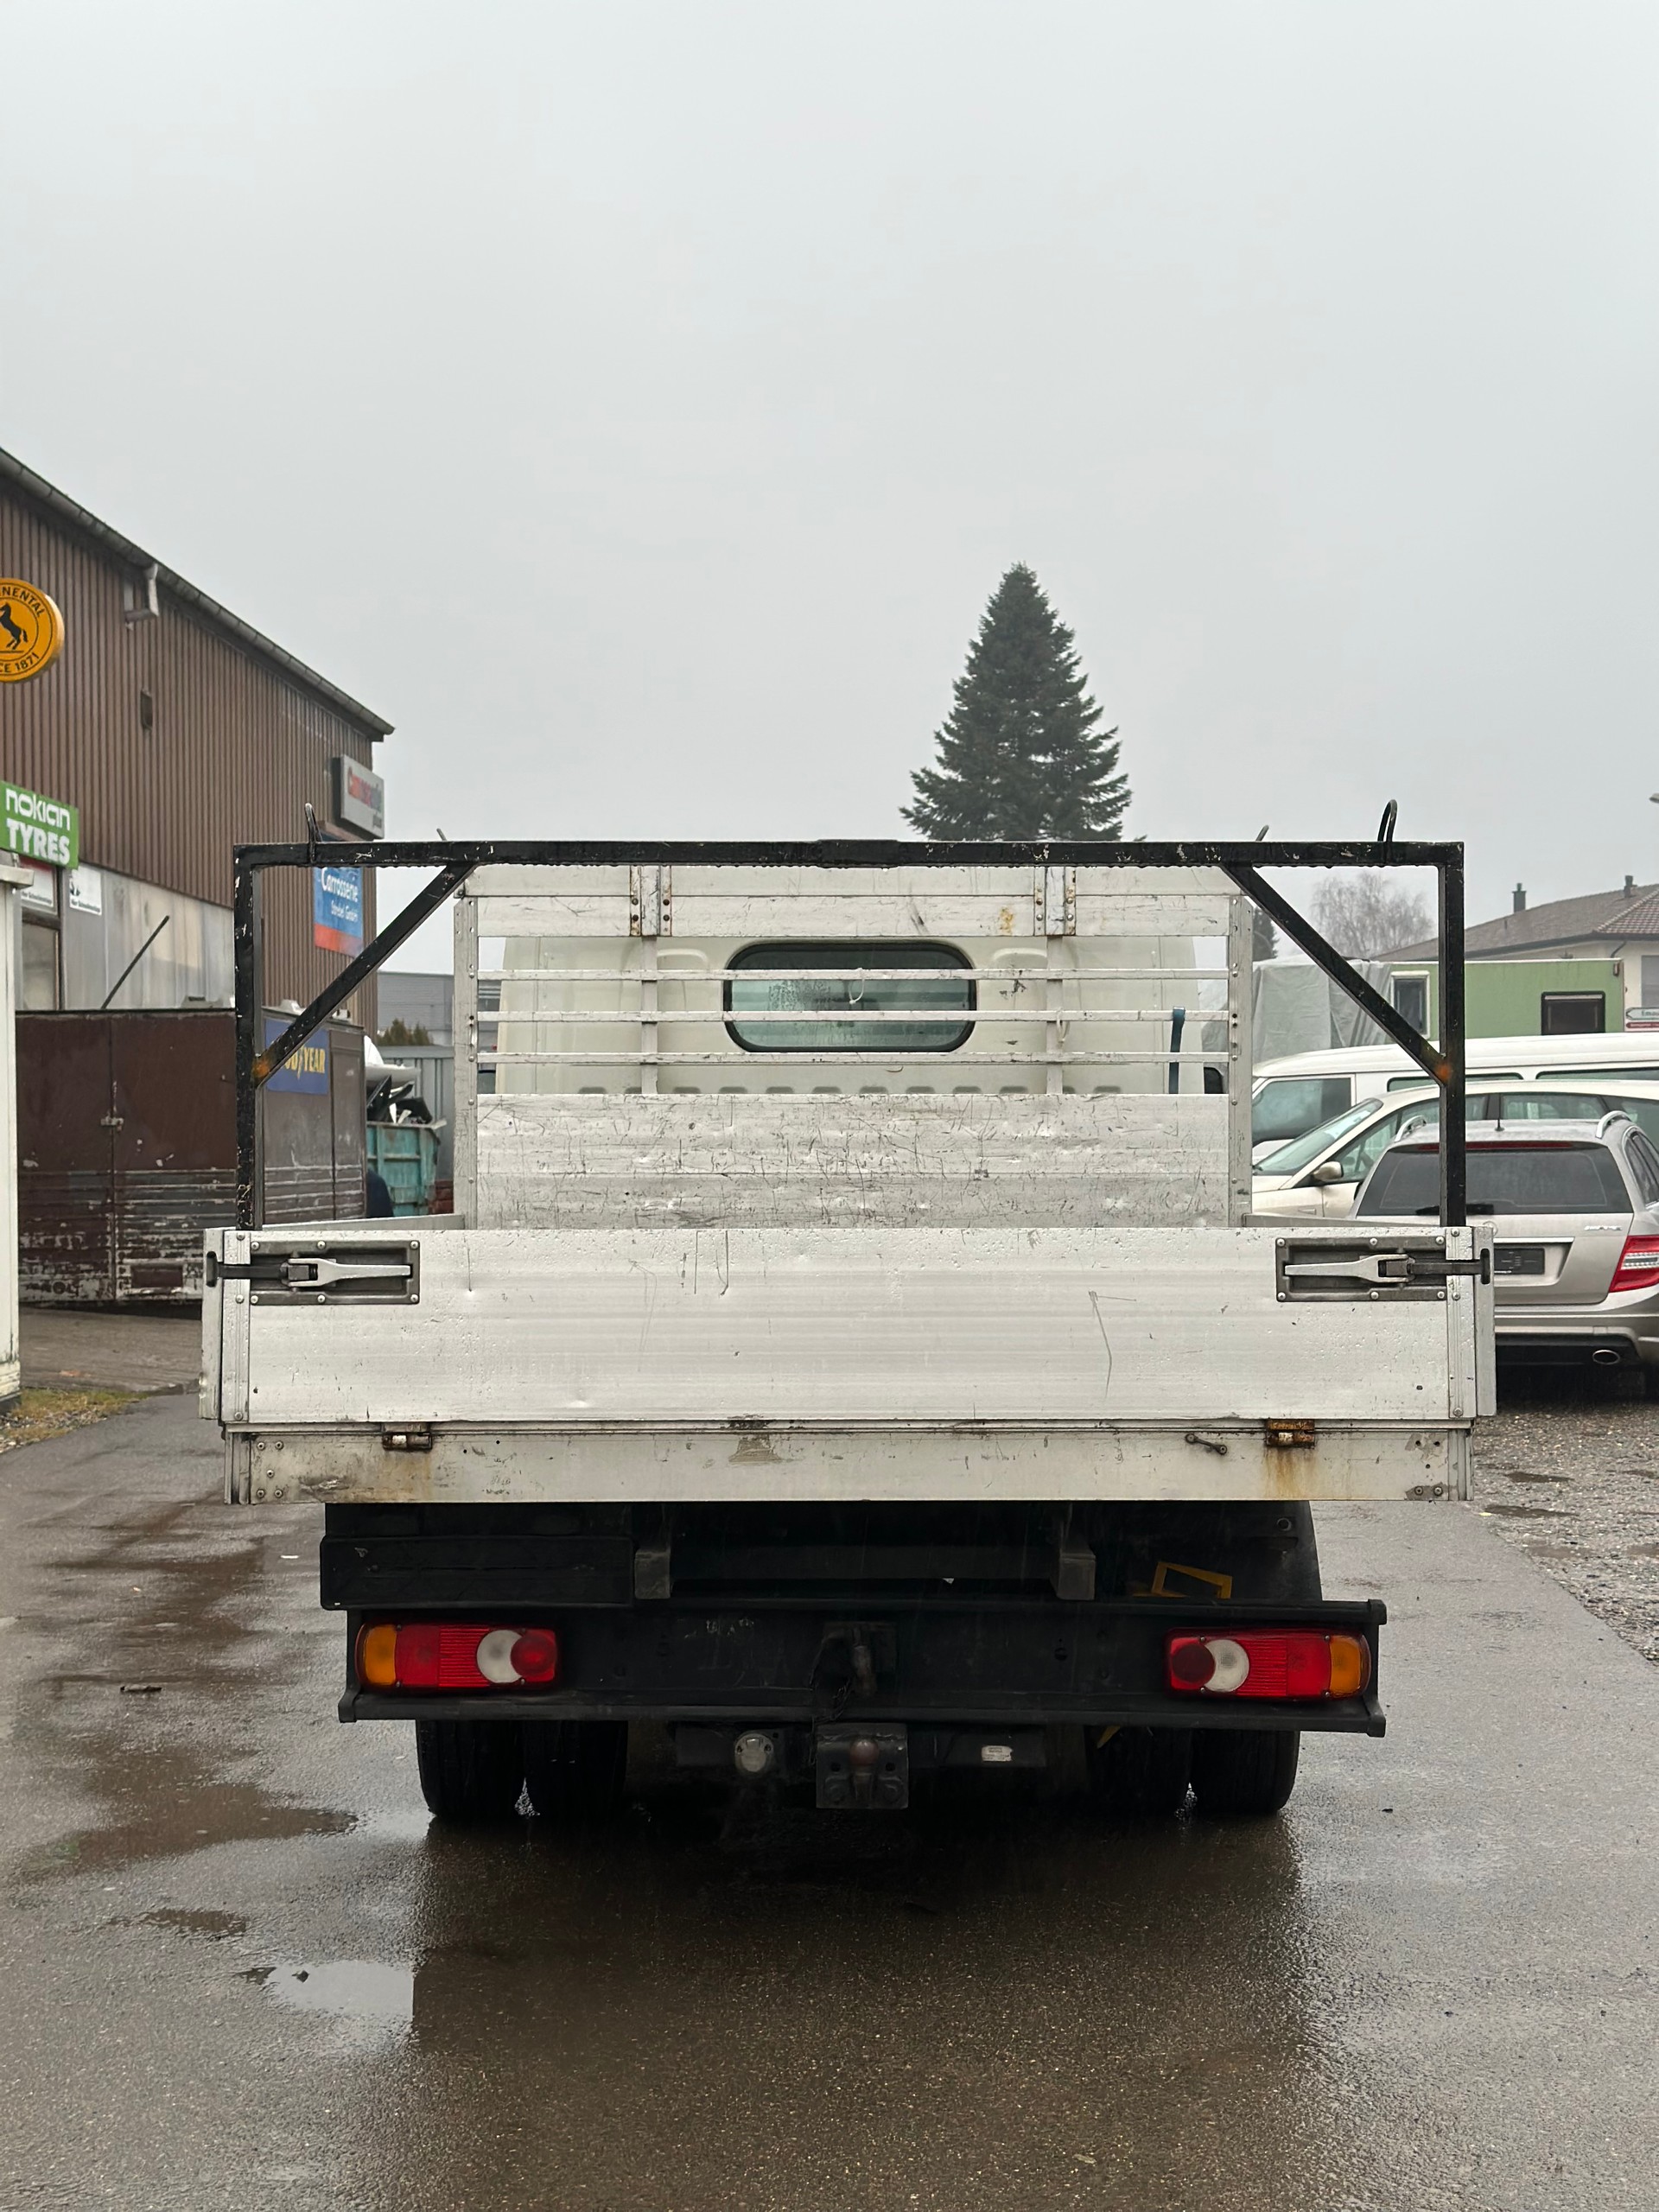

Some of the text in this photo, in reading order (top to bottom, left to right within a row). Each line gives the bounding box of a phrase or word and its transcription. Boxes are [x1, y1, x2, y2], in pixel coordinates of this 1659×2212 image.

[0, 586, 46, 619] NENTAL
[15, 652, 40, 671] 1871
[5, 787, 71, 831] nokian
[6, 817, 71, 865] TYRES
